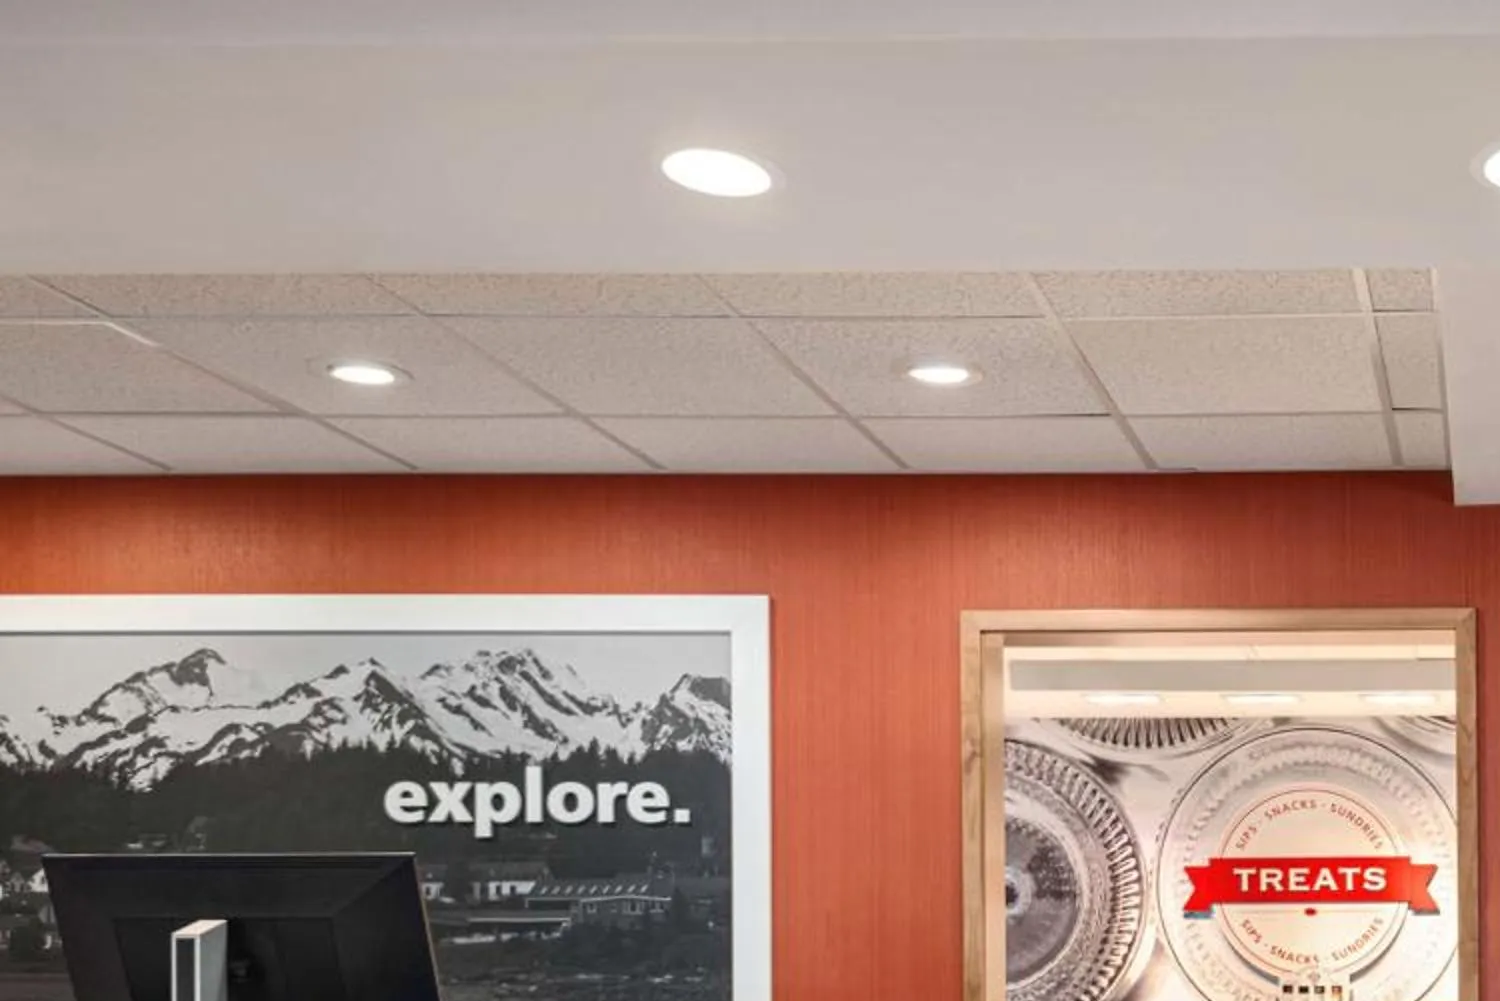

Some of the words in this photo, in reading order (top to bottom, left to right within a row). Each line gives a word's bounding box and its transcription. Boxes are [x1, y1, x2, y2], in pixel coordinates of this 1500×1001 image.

[384, 766, 691, 838] explore.
[1236, 825, 1258, 850] SIPS
[1264, 799, 1317, 820] SNACKS
[1330, 802, 1383, 850] SUNDRIES
[1233, 867, 1387, 892] TREATS
[1241, 919, 1263, 944] SIPS
[1270, 945, 1319, 964] SNACKS
[1331, 917, 1384, 961] SUNDRIES
